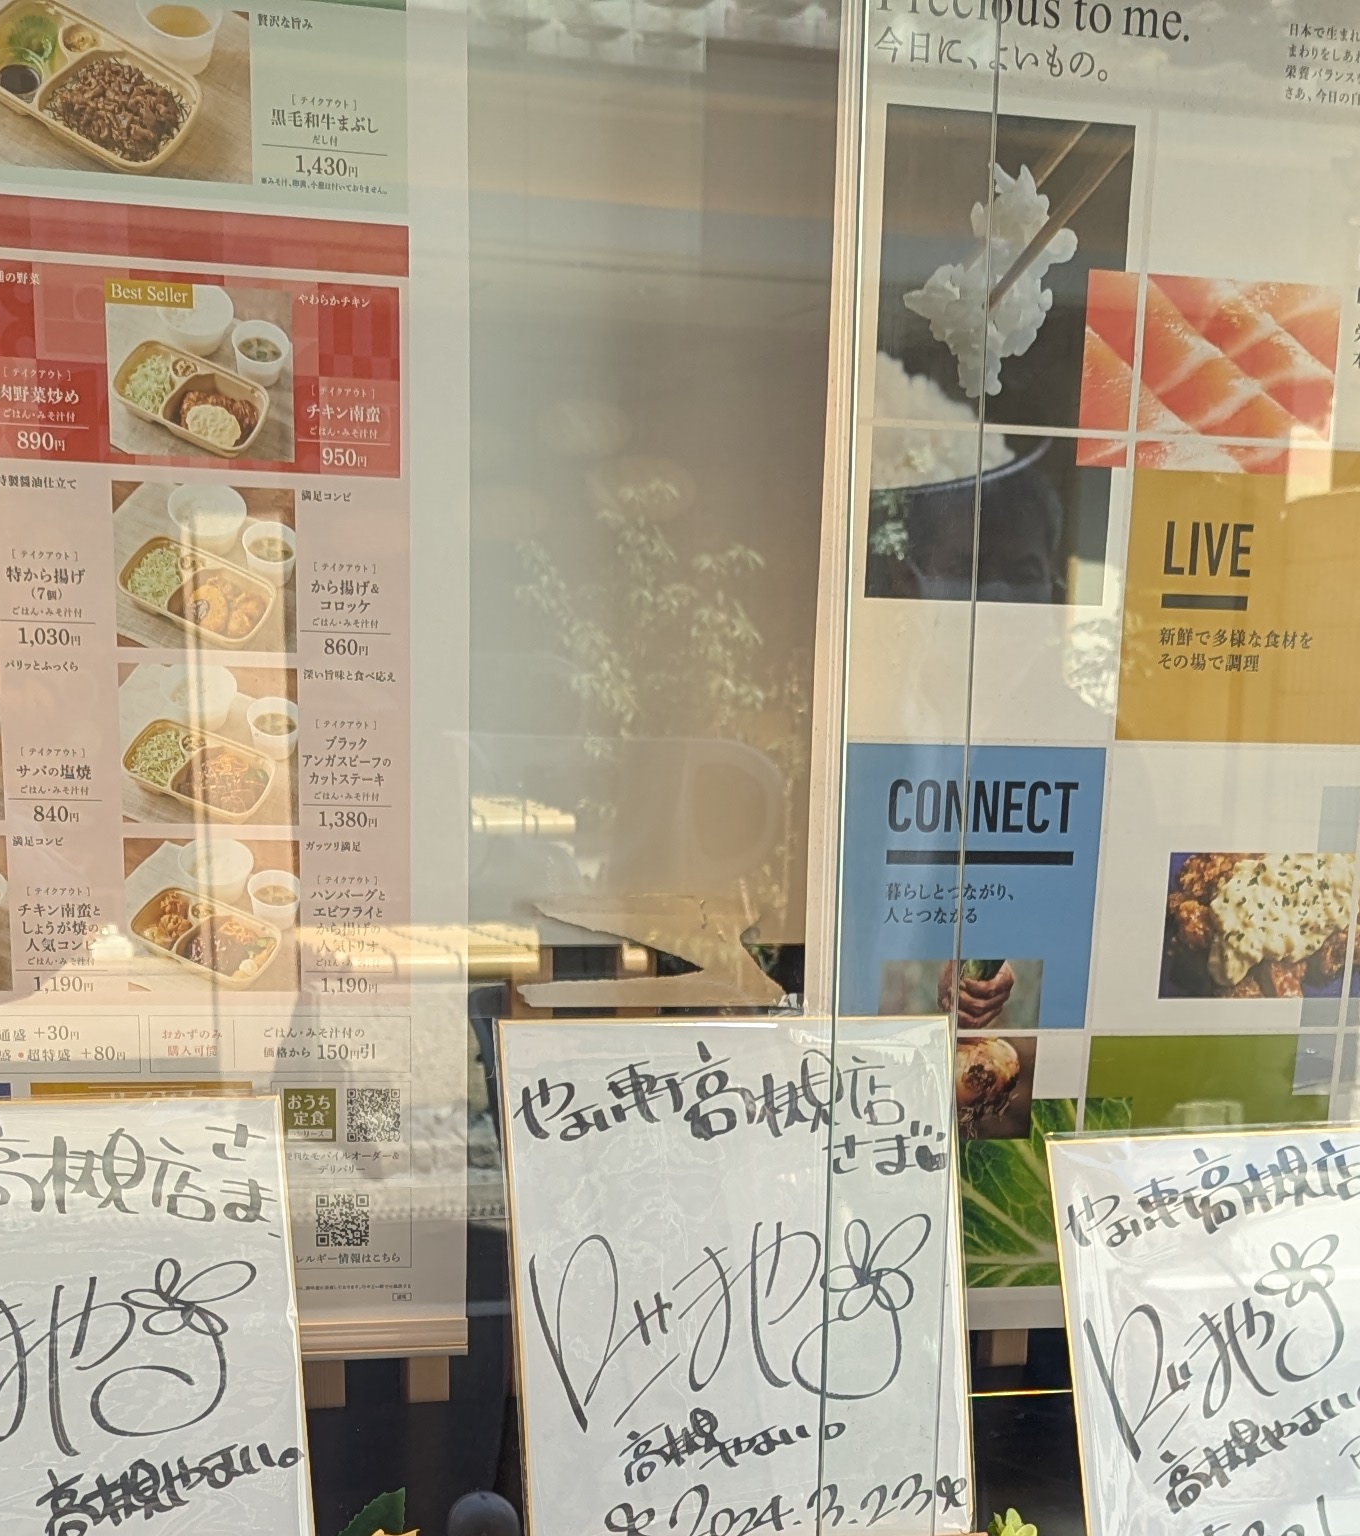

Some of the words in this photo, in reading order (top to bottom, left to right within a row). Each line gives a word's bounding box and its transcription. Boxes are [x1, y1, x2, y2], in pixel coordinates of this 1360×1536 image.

[257, 13, 313, 31] 贅沢な旨み
[1122, 6, 1190, 42] me.
[270, 109, 378, 135] 黒毛和牛まぶし
[313, 134, 338, 147] だし付
[296, 154, 359, 179] 1,430円
[111, 285, 142, 303] Best
[146, 287, 188, 305] Seller
[298, 294, 371, 309] やわらかチキン
[307, 404, 381, 423] チキン南蛮
[17, 430, 66, 452] 890円
[321, 448, 367, 468] 950円
[301, 489, 351, 503] 満足コンビ
[1163, 520, 1255, 579] LIVE
[6, 566, 86, 586] 特から揚げ
[311, 579, 379, 596] から揚げ&
[320, 598, 371, 614] コロッケ
[18, 627, 81, 648] 1,030円
[1158, 626, 1313, 651] 新鮮で多様な食材を
[323, 638, 369, 657] 860円
[1157, 652, 1261, 674] その場で調理
[303, 668, 396, 684] 深い旨味と食べ応え
[325, 735, 367, 750] ブラック
[302, 752, 392, 769] アンガスビーフの
[16, 764, 91, 781] サバの塩焼
[309, 770, 384, 787] カットステーキ
[33, 805, 79, 824] 840円
[887, 778, 1080, 835] CONNECT
[318, 810, 378, 830] 1,380円
[13, 835, 64, 849] 満足コンビ
[305, 840, 361, 854] ガッツリ満足
[310, 888, 386, 903] ハンバーグと
[17, 903, 101, 920] チキン南蛮と
[313, 905, 384, 920] エビフライと
[22, 920, 98, 937] しょうが焼の
[34, 976, 94, 994] 1,190円
[321, 976, 378, 995] 1,190円
[162, 1028, 223, 1041] おかずのみ
[263, 1026, 365, 1040] ごはん・みそ汁付の
[27, 1047, 71, 1062] 超特盛
[167, 1043, 217, 1057] 購入可能
[263, 1046, 311, 1059] 価格から
[317, 1043, 377, 1061] 150円引
[287, 1094, 331, 1110] おうち
[293, 1110, 326, 1126] 定食
[319, 1164, 366, 1173] デリバリー
